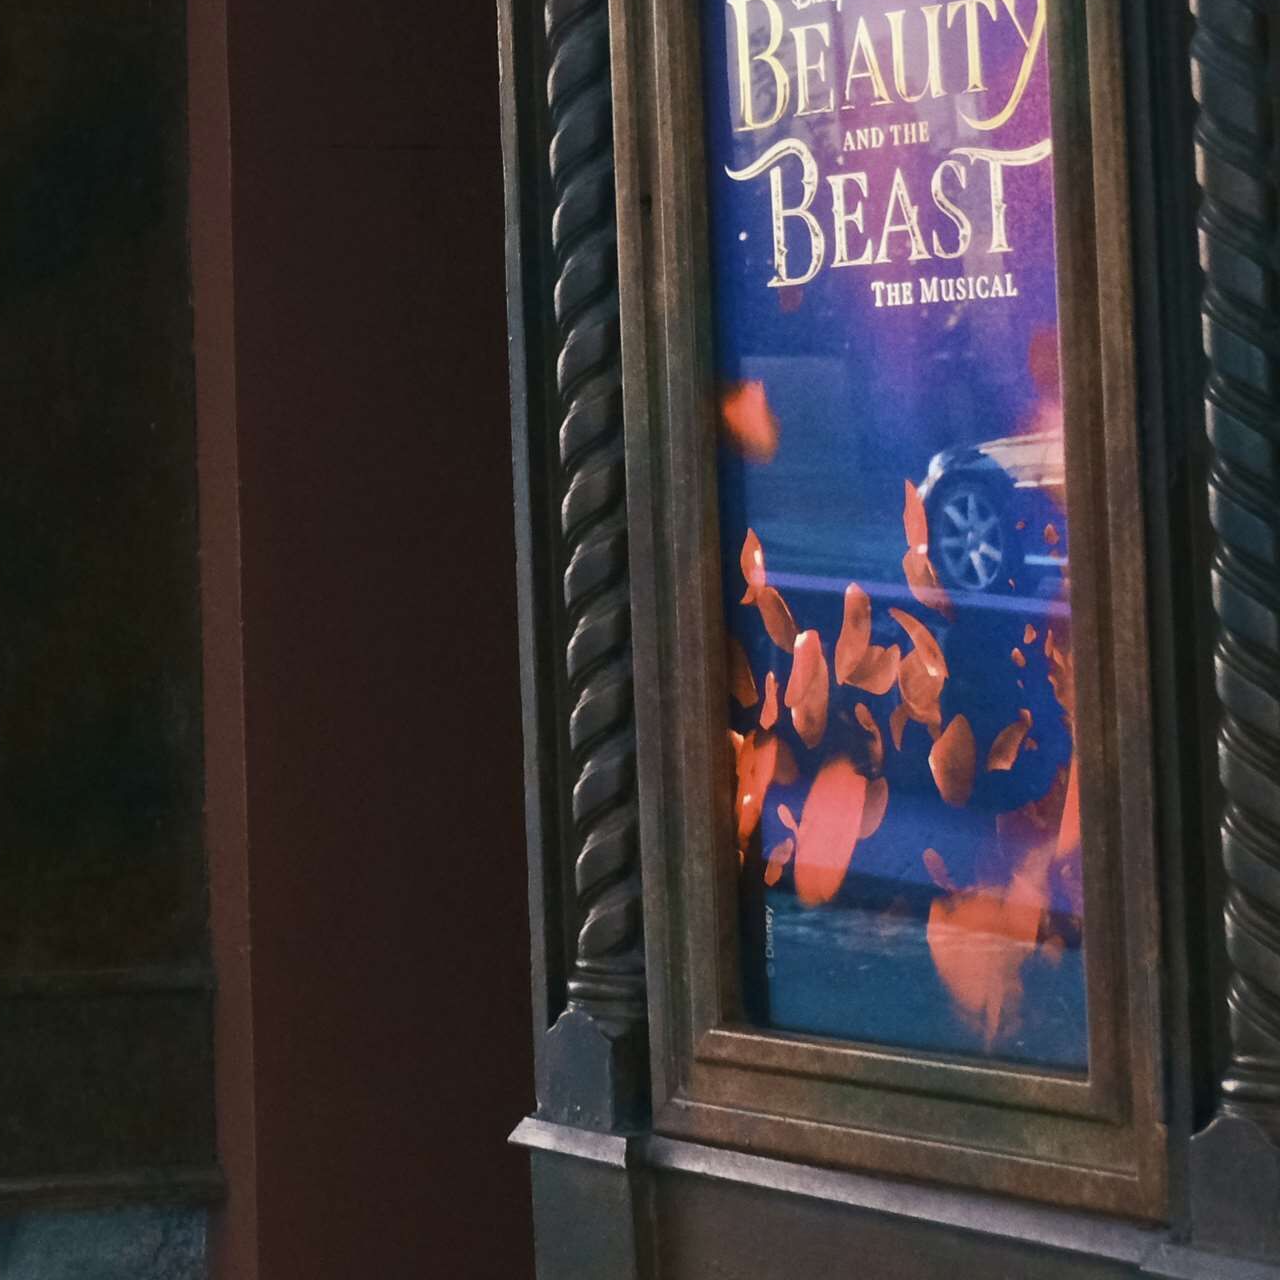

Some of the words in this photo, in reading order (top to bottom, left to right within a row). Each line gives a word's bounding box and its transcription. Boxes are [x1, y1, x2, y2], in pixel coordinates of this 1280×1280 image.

[842, 126, 884, 152] AND
[889, 120, 930, 146] THE
[724, 136, 1051, 290] BEAST
[871, 279, 912, 307] THE
[920, 272, 1018, 302] MUSICAL
